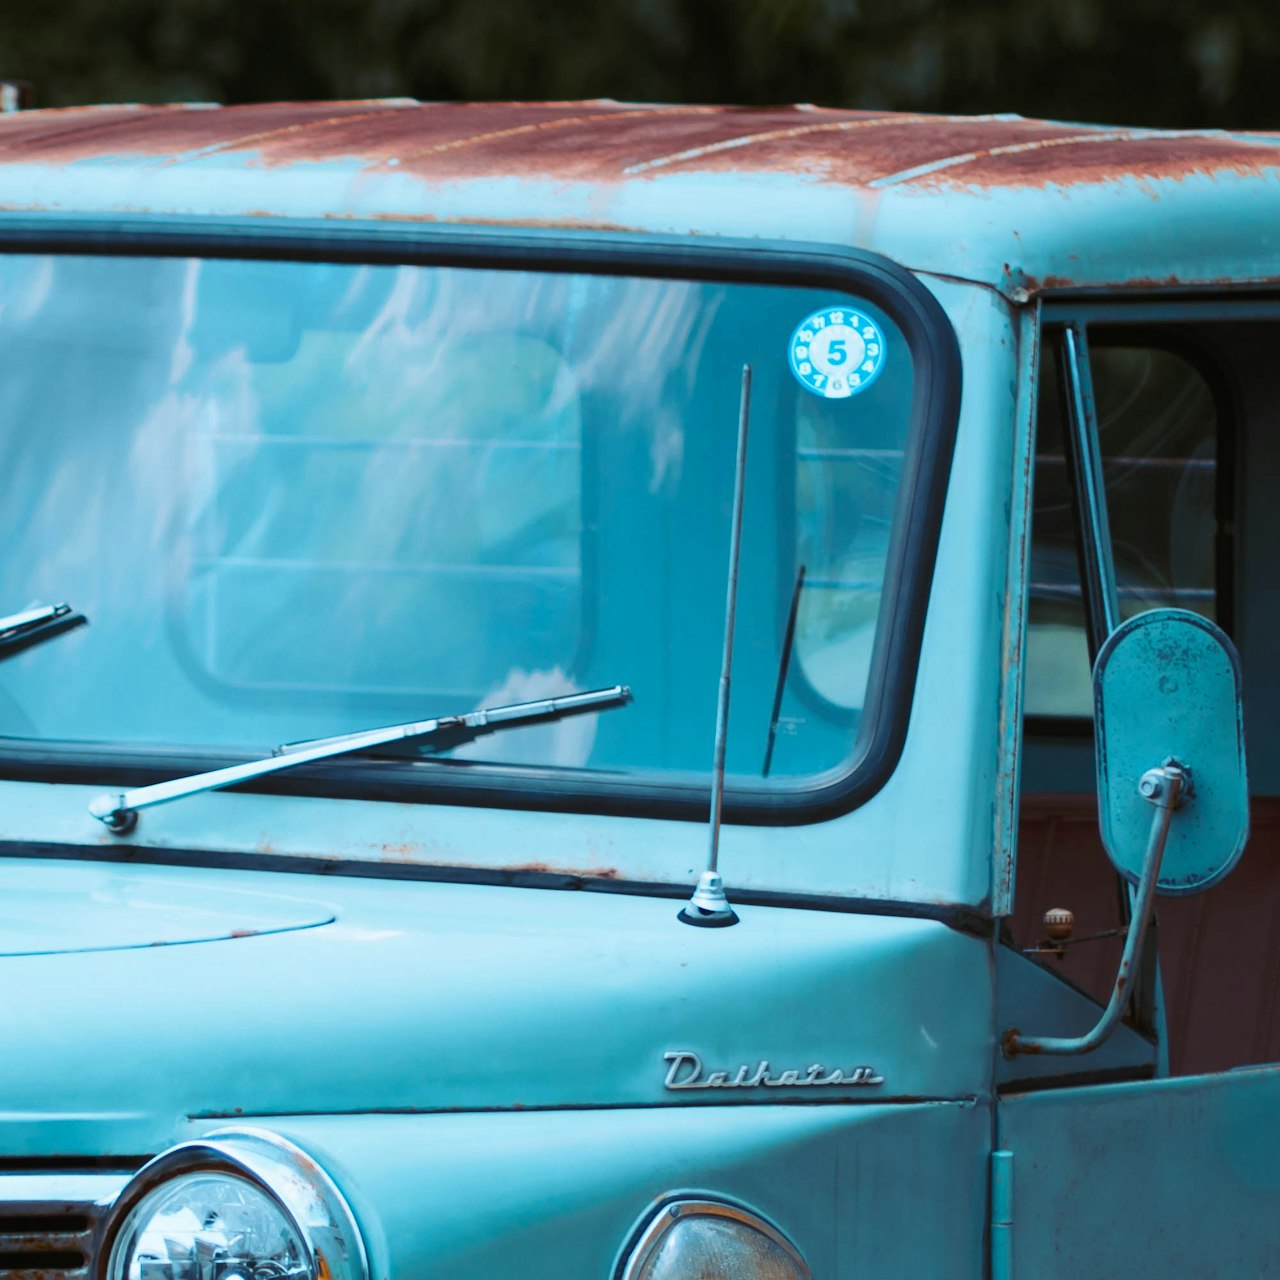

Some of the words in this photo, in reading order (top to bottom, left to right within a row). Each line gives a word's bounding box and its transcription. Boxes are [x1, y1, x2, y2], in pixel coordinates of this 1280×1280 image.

[812, 316, 826, 329] 11
[829, 311, 844, 324] 12
[850, 315, 859, 328] 1
[798, 330, 814, 342] 10
[862, 326, 875, 339] 2
[826, 339, 847, 366] 5
[867, 343, 879, 357] 3
[799, 362, 812, 375] 8
[861, 360, 874, 373] 4
[813, 374, 825, 387] 7
[663, 1050, 884, 1090] Daihatsu
